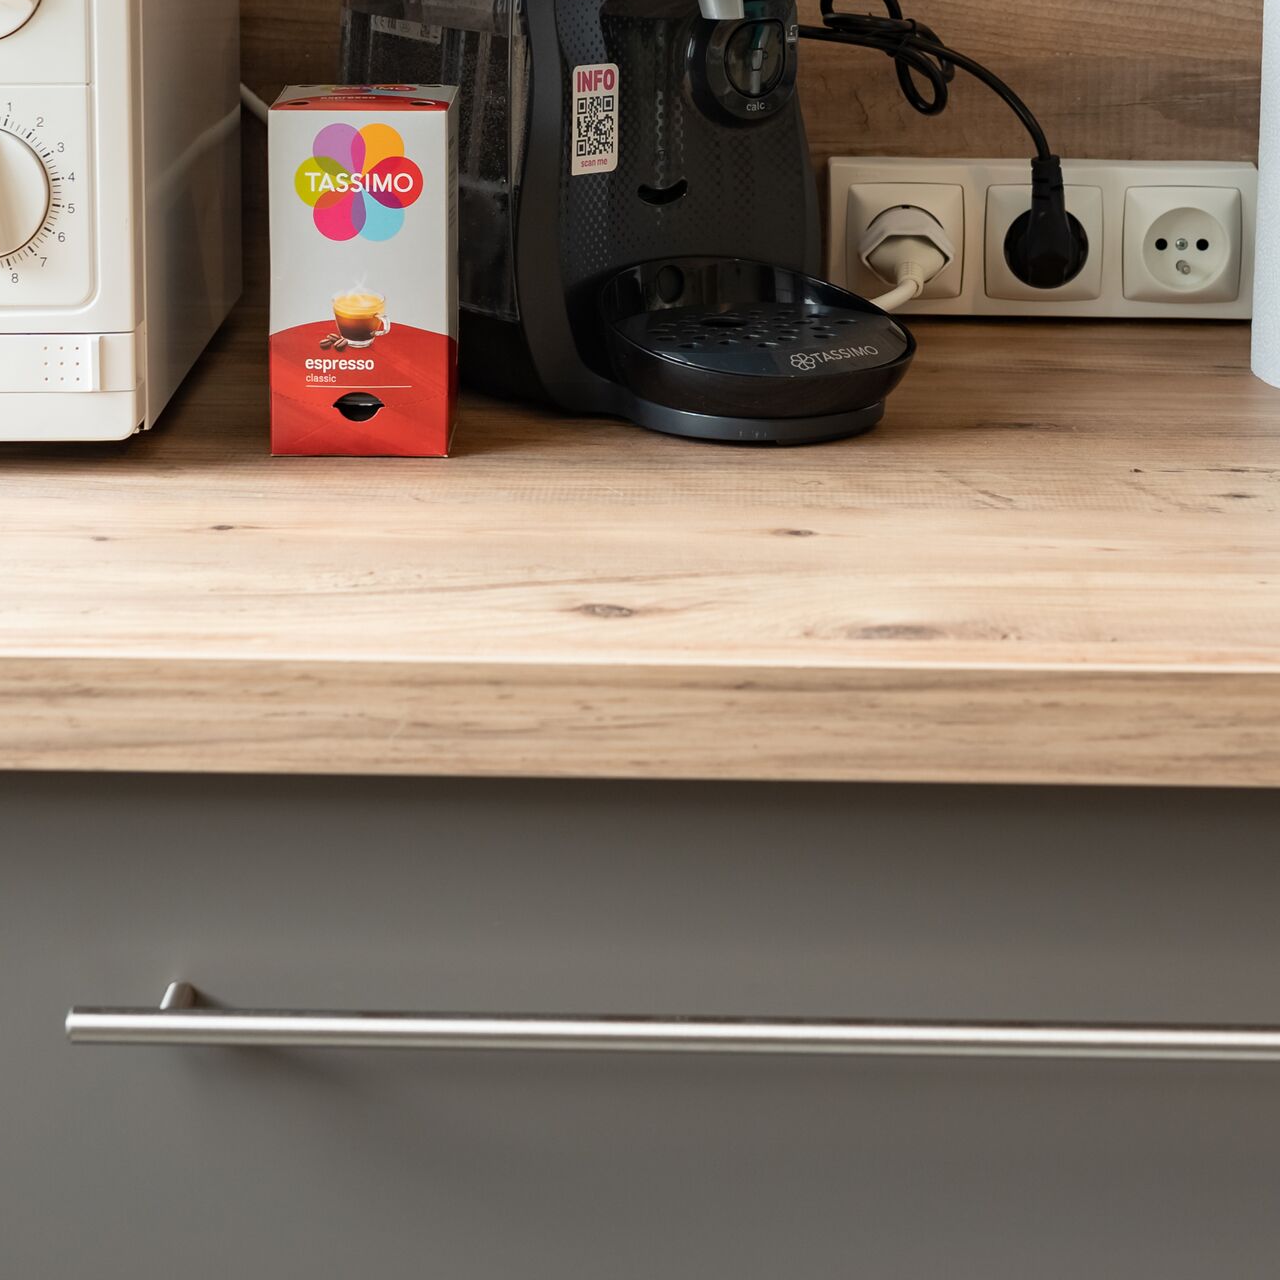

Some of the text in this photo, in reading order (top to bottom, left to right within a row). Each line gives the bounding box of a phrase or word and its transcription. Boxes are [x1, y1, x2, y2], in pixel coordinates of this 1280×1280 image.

[576, 68, 616, 93] INFO
[6, 102, 12, 112] 1
[746, 102, 766, 112] calc
[36, 116, 44, 128] 2
[57, 142, 65, 153] 3
[580, 158, 608, 168] scan me
[67, 171, 75, 182] 4
[304, 172, 414, 193] TASSIMO
[67, 202, 76, 214] 5
[58, 231, 66, 243] 6
[39, 257, 48, 268] 7
[11, 273, 19, 284] 8
[809, 345, 879, 363] TASSIMO
[304, 358, 375, 373] espresso
[305, 373, 337, 383] classic
